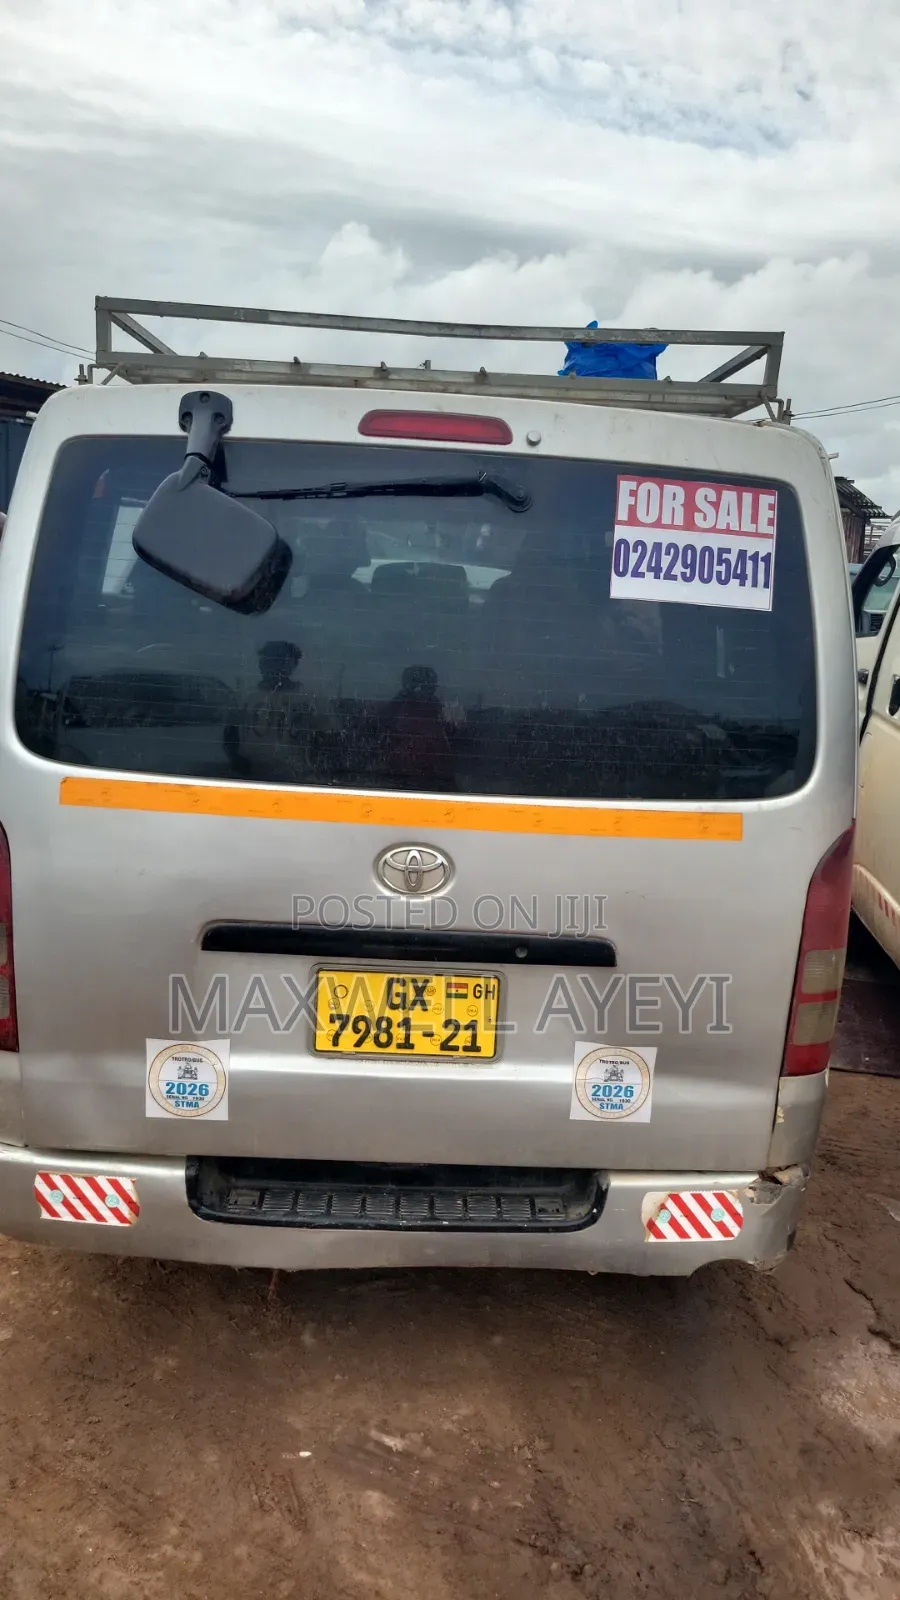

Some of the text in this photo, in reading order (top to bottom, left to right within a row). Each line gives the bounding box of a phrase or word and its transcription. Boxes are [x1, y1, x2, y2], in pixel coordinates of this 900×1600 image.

[617, 480, 775, 534] FOR SALE
[613, 538, 772, 589] 0242905411
[386, 977, 430, 1012] GX
[472, 983, 496, 1000] GH
[329, 1013, 482, 1053] 7981-21
[165, 1081, 209, 1096] 2026
[591, 1084, 634, 1098] 2026
[599, 1102, 624, 1110] STMA
